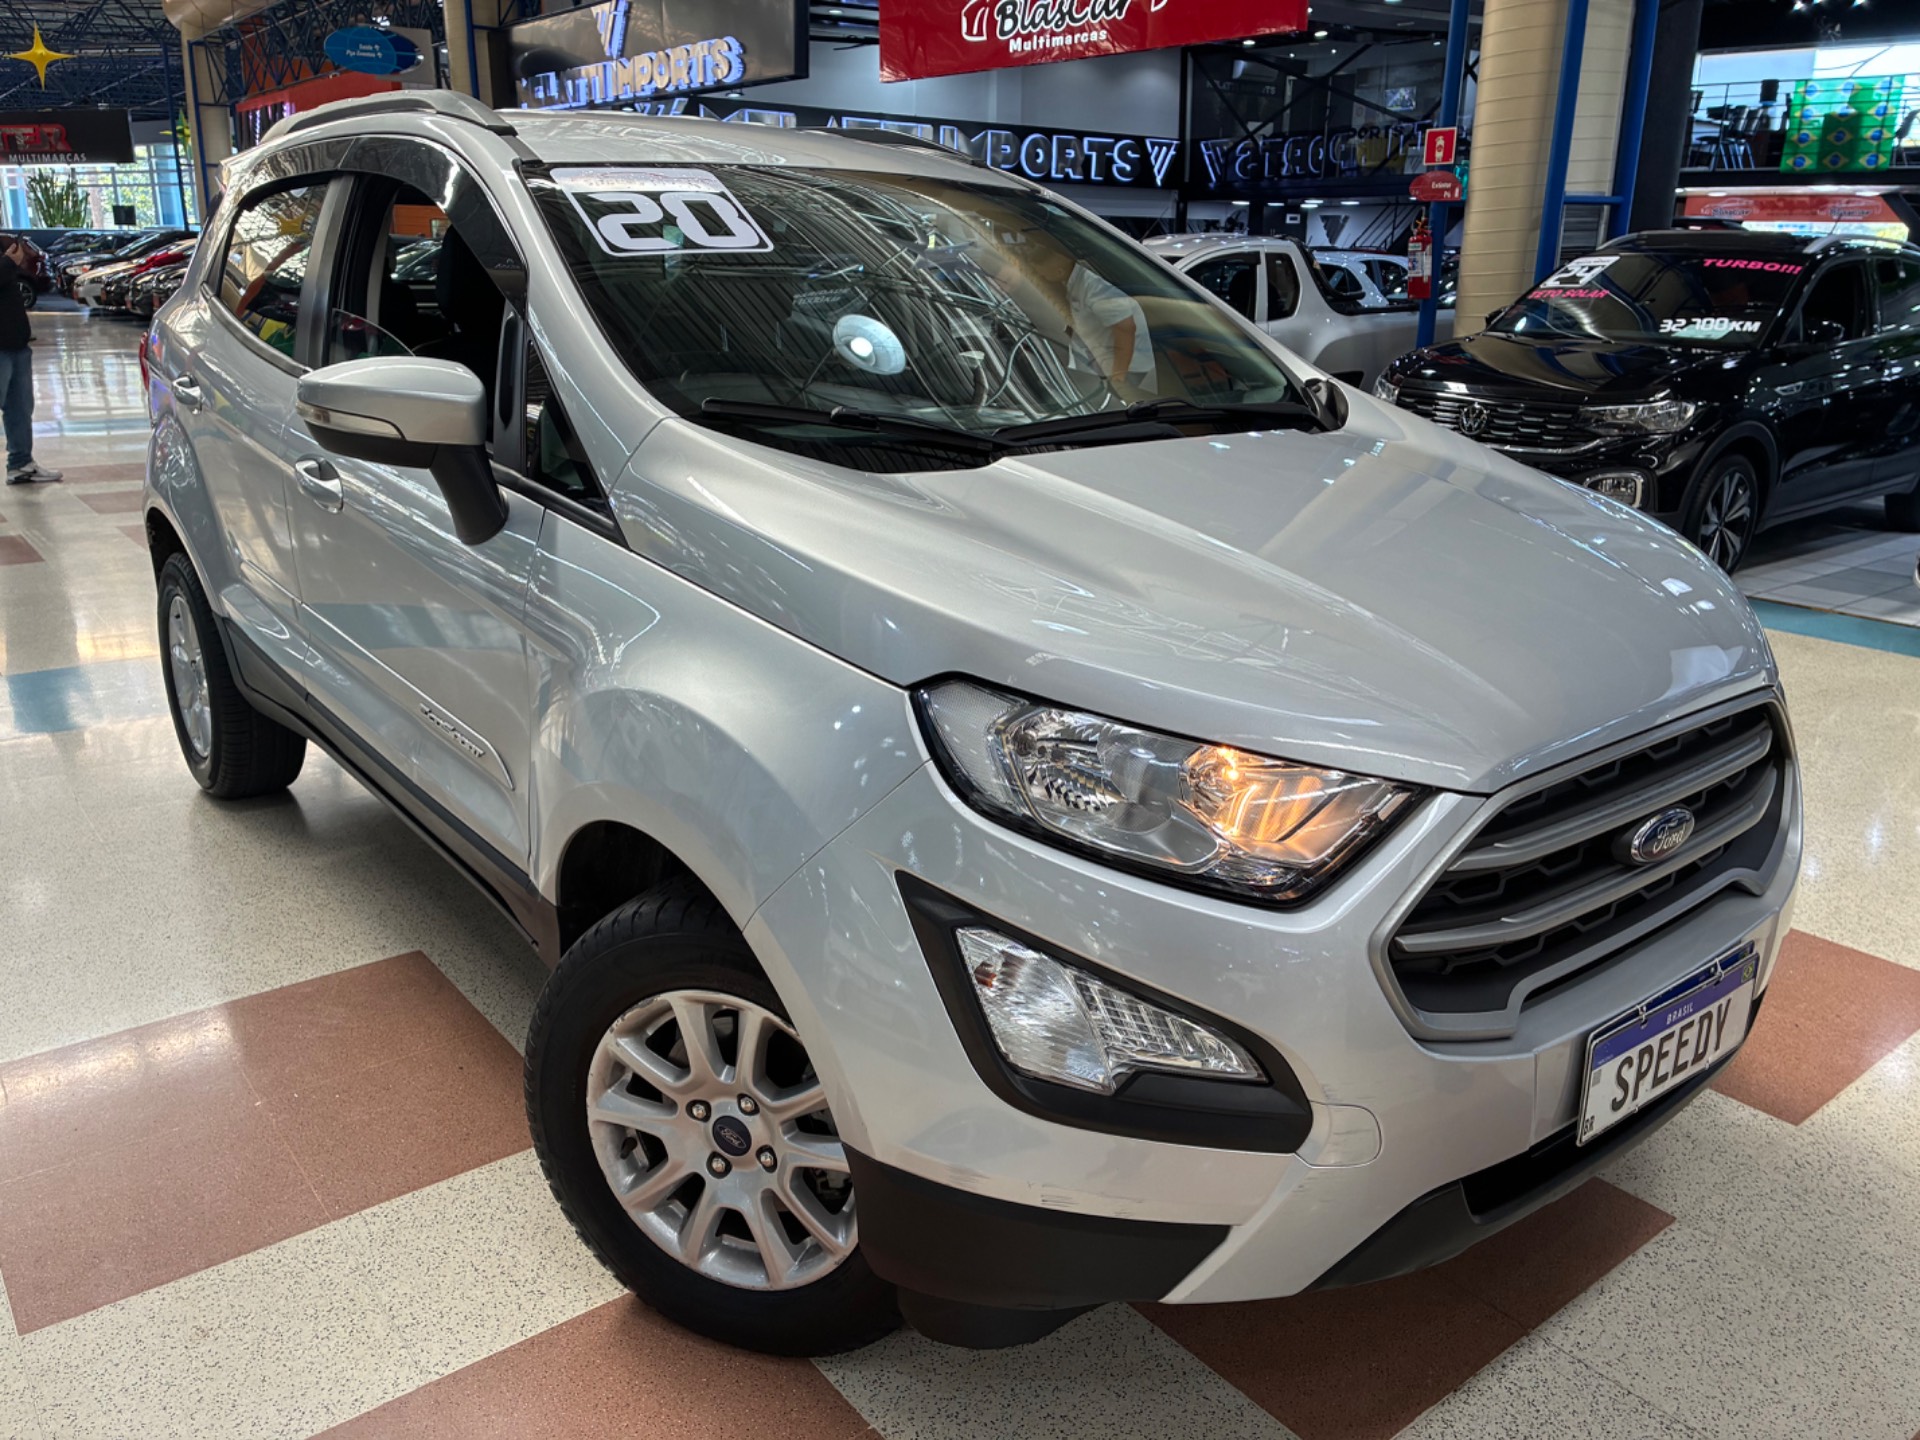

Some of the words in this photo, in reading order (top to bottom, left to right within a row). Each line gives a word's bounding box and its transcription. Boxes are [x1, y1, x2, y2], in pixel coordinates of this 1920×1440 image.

[1008, 28, 1108, 53] Multimarcas
[610, 36, 744, 98] IMPORTS
[8, 153, 88, 163] MULTIMARCAS
[586, 190, 762, 250] 20
[1703, 258, 1803, 275] TURBO!!!
[1528, 289, 1563, 299] TETO
[1563, 289, 1609, 299] SOLAR
[1665, 1001, 1694, 1027] BRASIL
[1610, 996, 1732, 1113] SPEEDY
